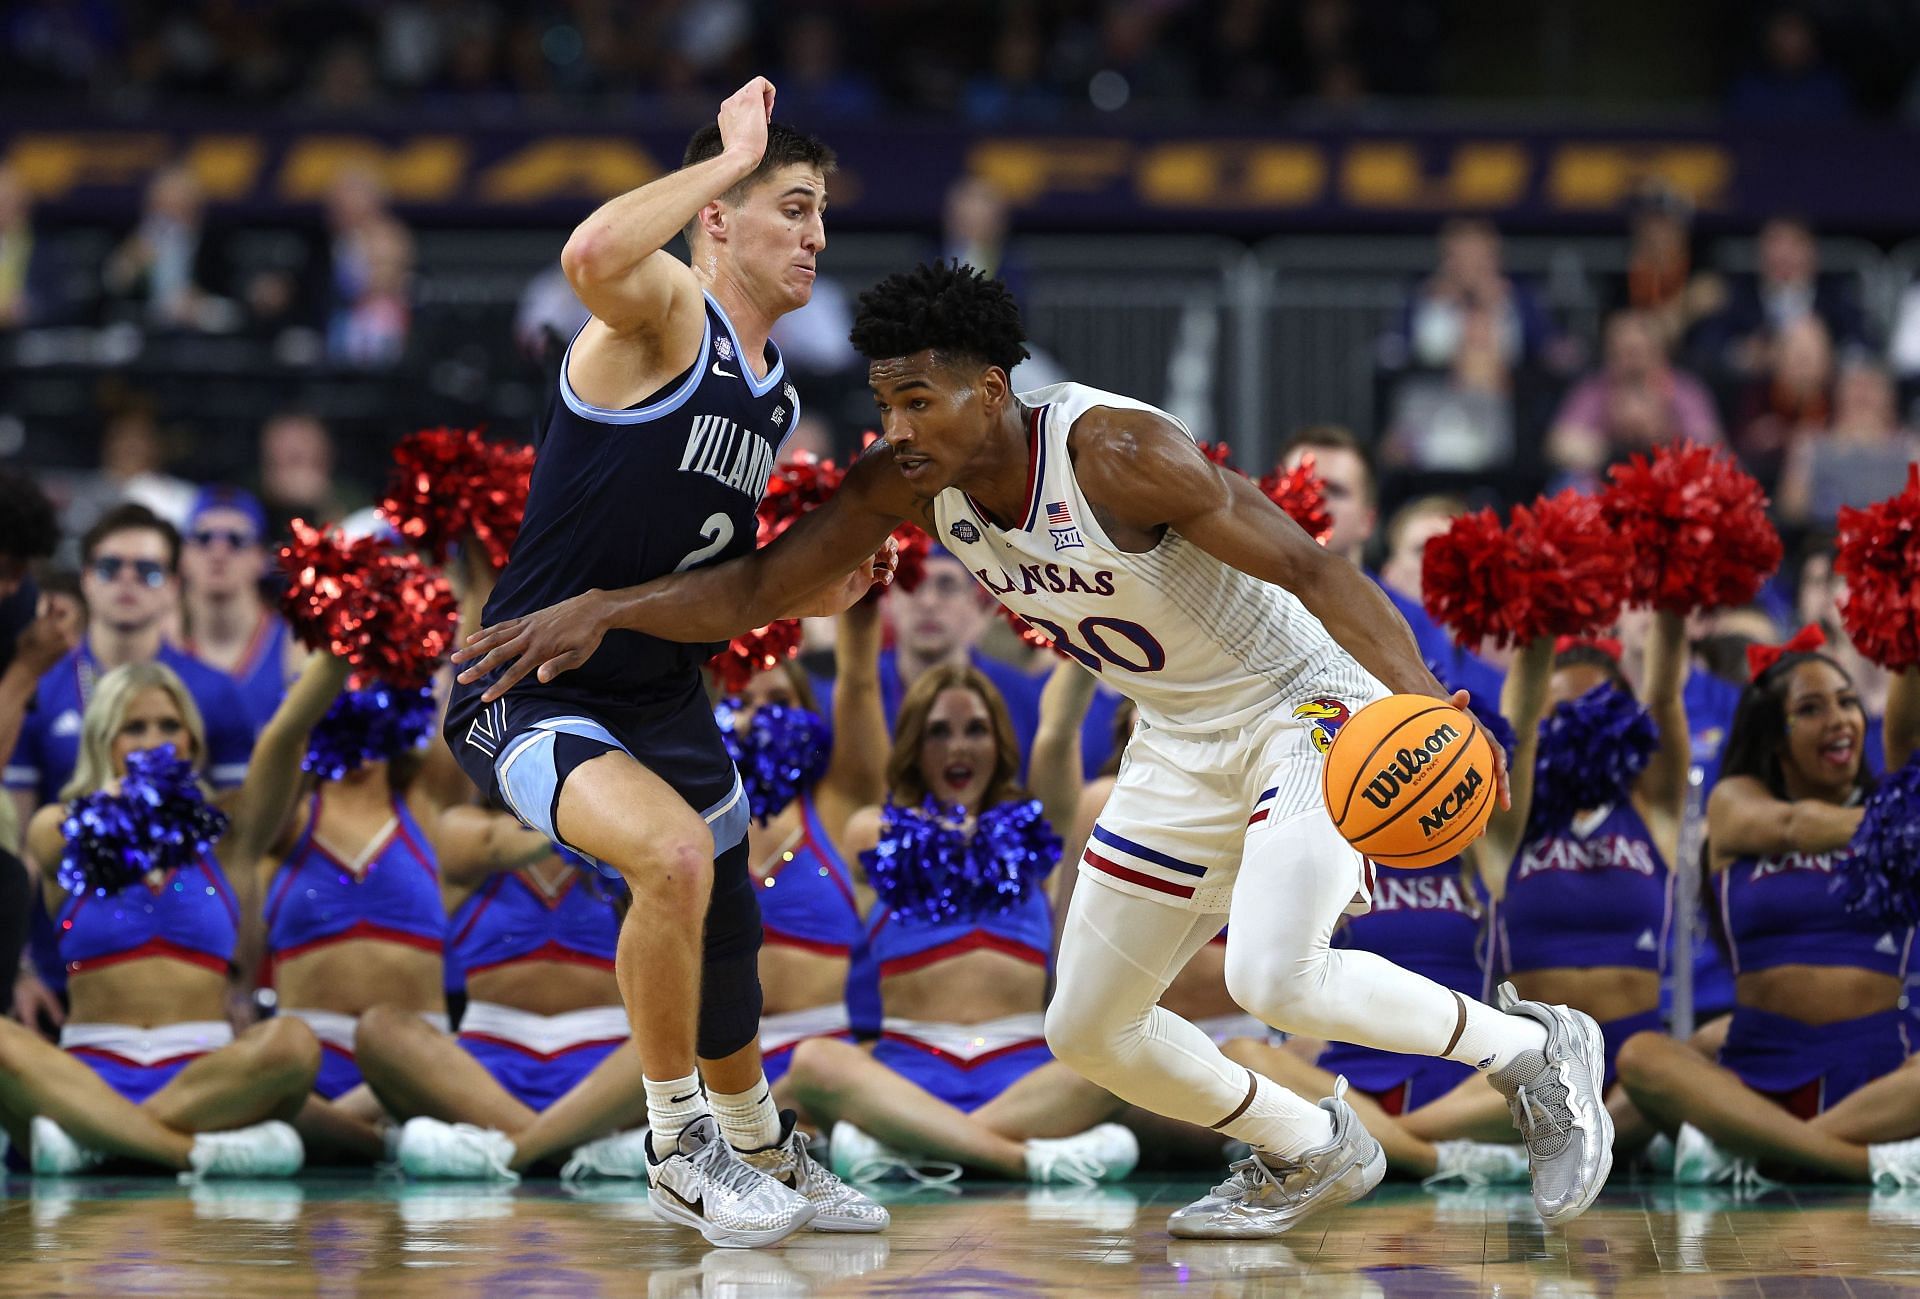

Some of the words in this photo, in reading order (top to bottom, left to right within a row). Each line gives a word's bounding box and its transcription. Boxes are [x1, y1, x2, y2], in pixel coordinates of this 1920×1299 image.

[5, 131, 690, 206] FINA
[672, 512, 734, 573] 2
[1049, 528, 1084, 551] XII
[976, 563, 1115, 596] KANSAS
[1361, 723, 1460, 809] Wilson
[1412, 771, 1428, 786] EVO
[1426, 758, 1440, 773] NXT
[1418, 765, 1483, 837] NCAA
[1518, 834, 1655, 878] KANSAS
[1372, 876, 1480, 919] ANSA
